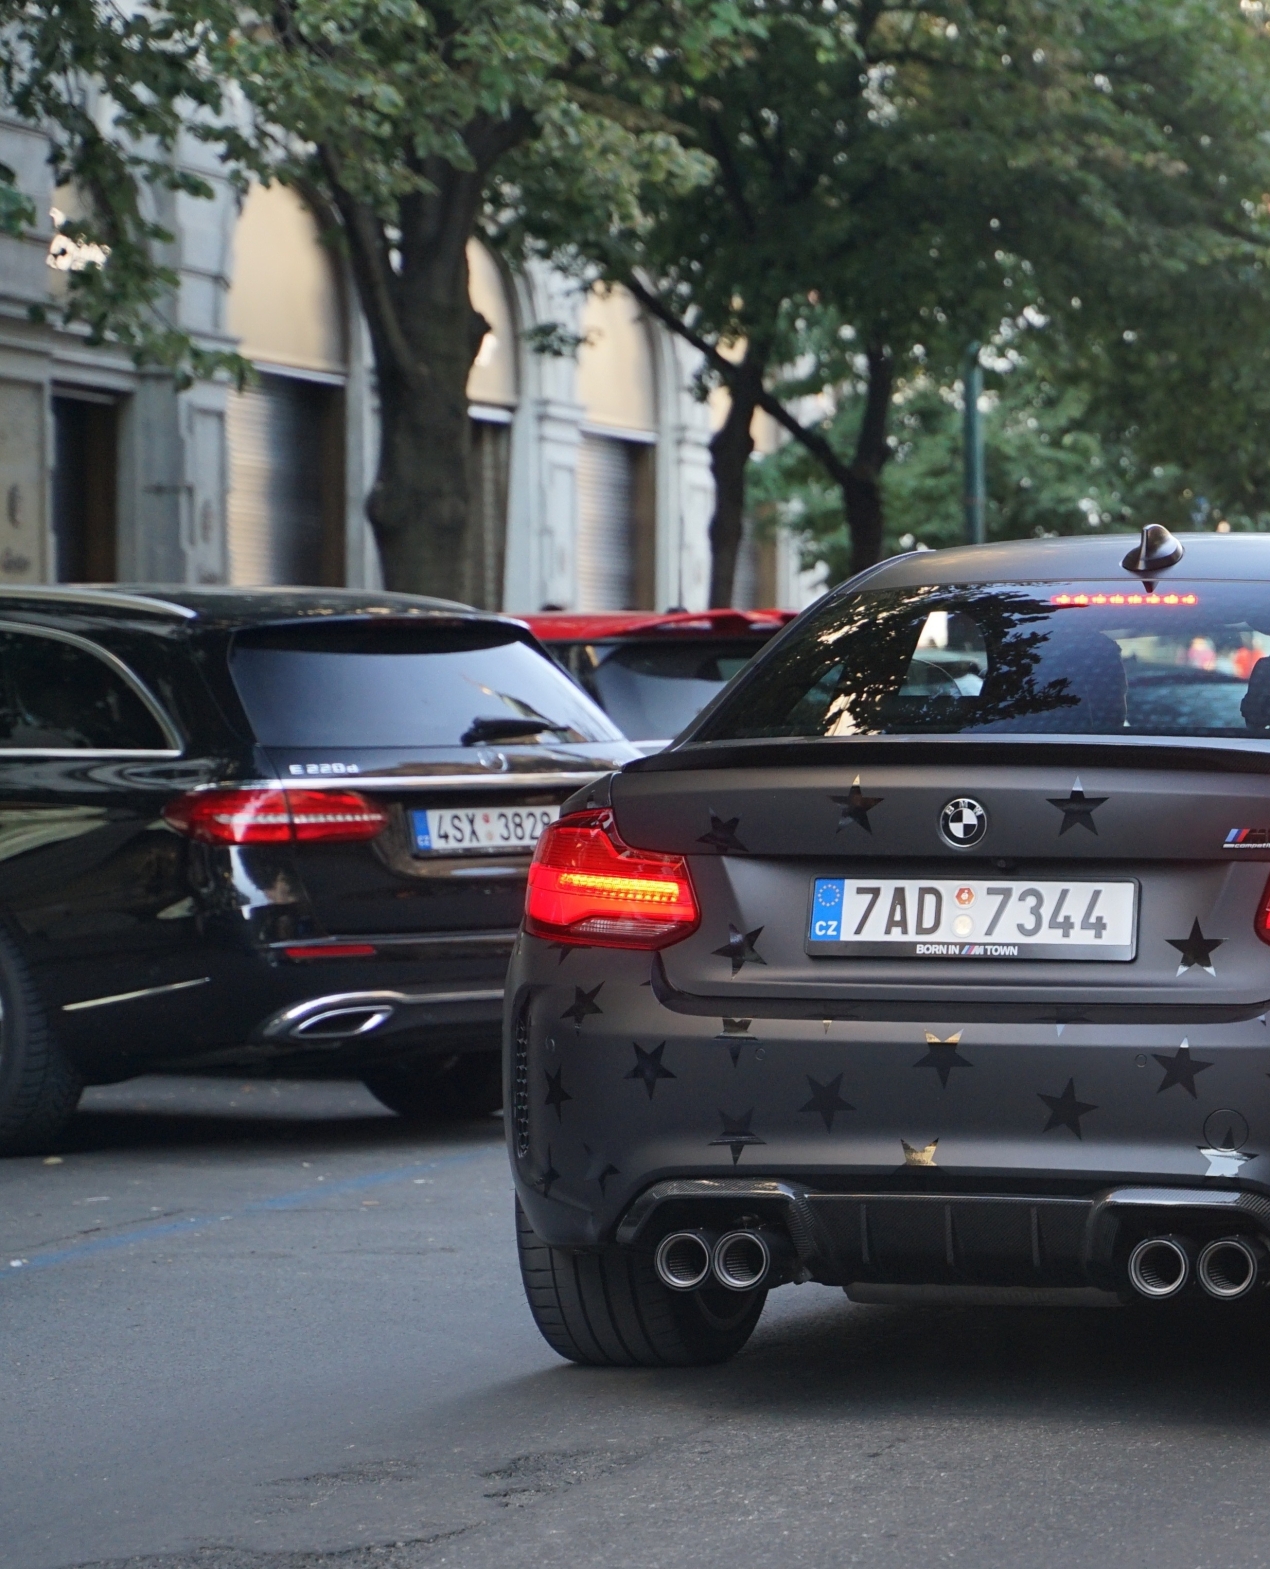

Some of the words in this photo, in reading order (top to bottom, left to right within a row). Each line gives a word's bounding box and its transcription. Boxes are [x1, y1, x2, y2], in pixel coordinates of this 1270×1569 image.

[289, 764, 304, 775] E
[306, 762, 360, 775] 220d
[944, 799, 984, 816] BMW
[437, 812, 480, 845] 4SX
[854, 886, 943, 935] 7AD
[984, 887, 1107, 939] 7344
[815, 920, 838, 936] CZ
[916, 944, 947, 956] BORN
[948, 944, 960, 956] IN
[985, 945, 1018, 956] TOWN
